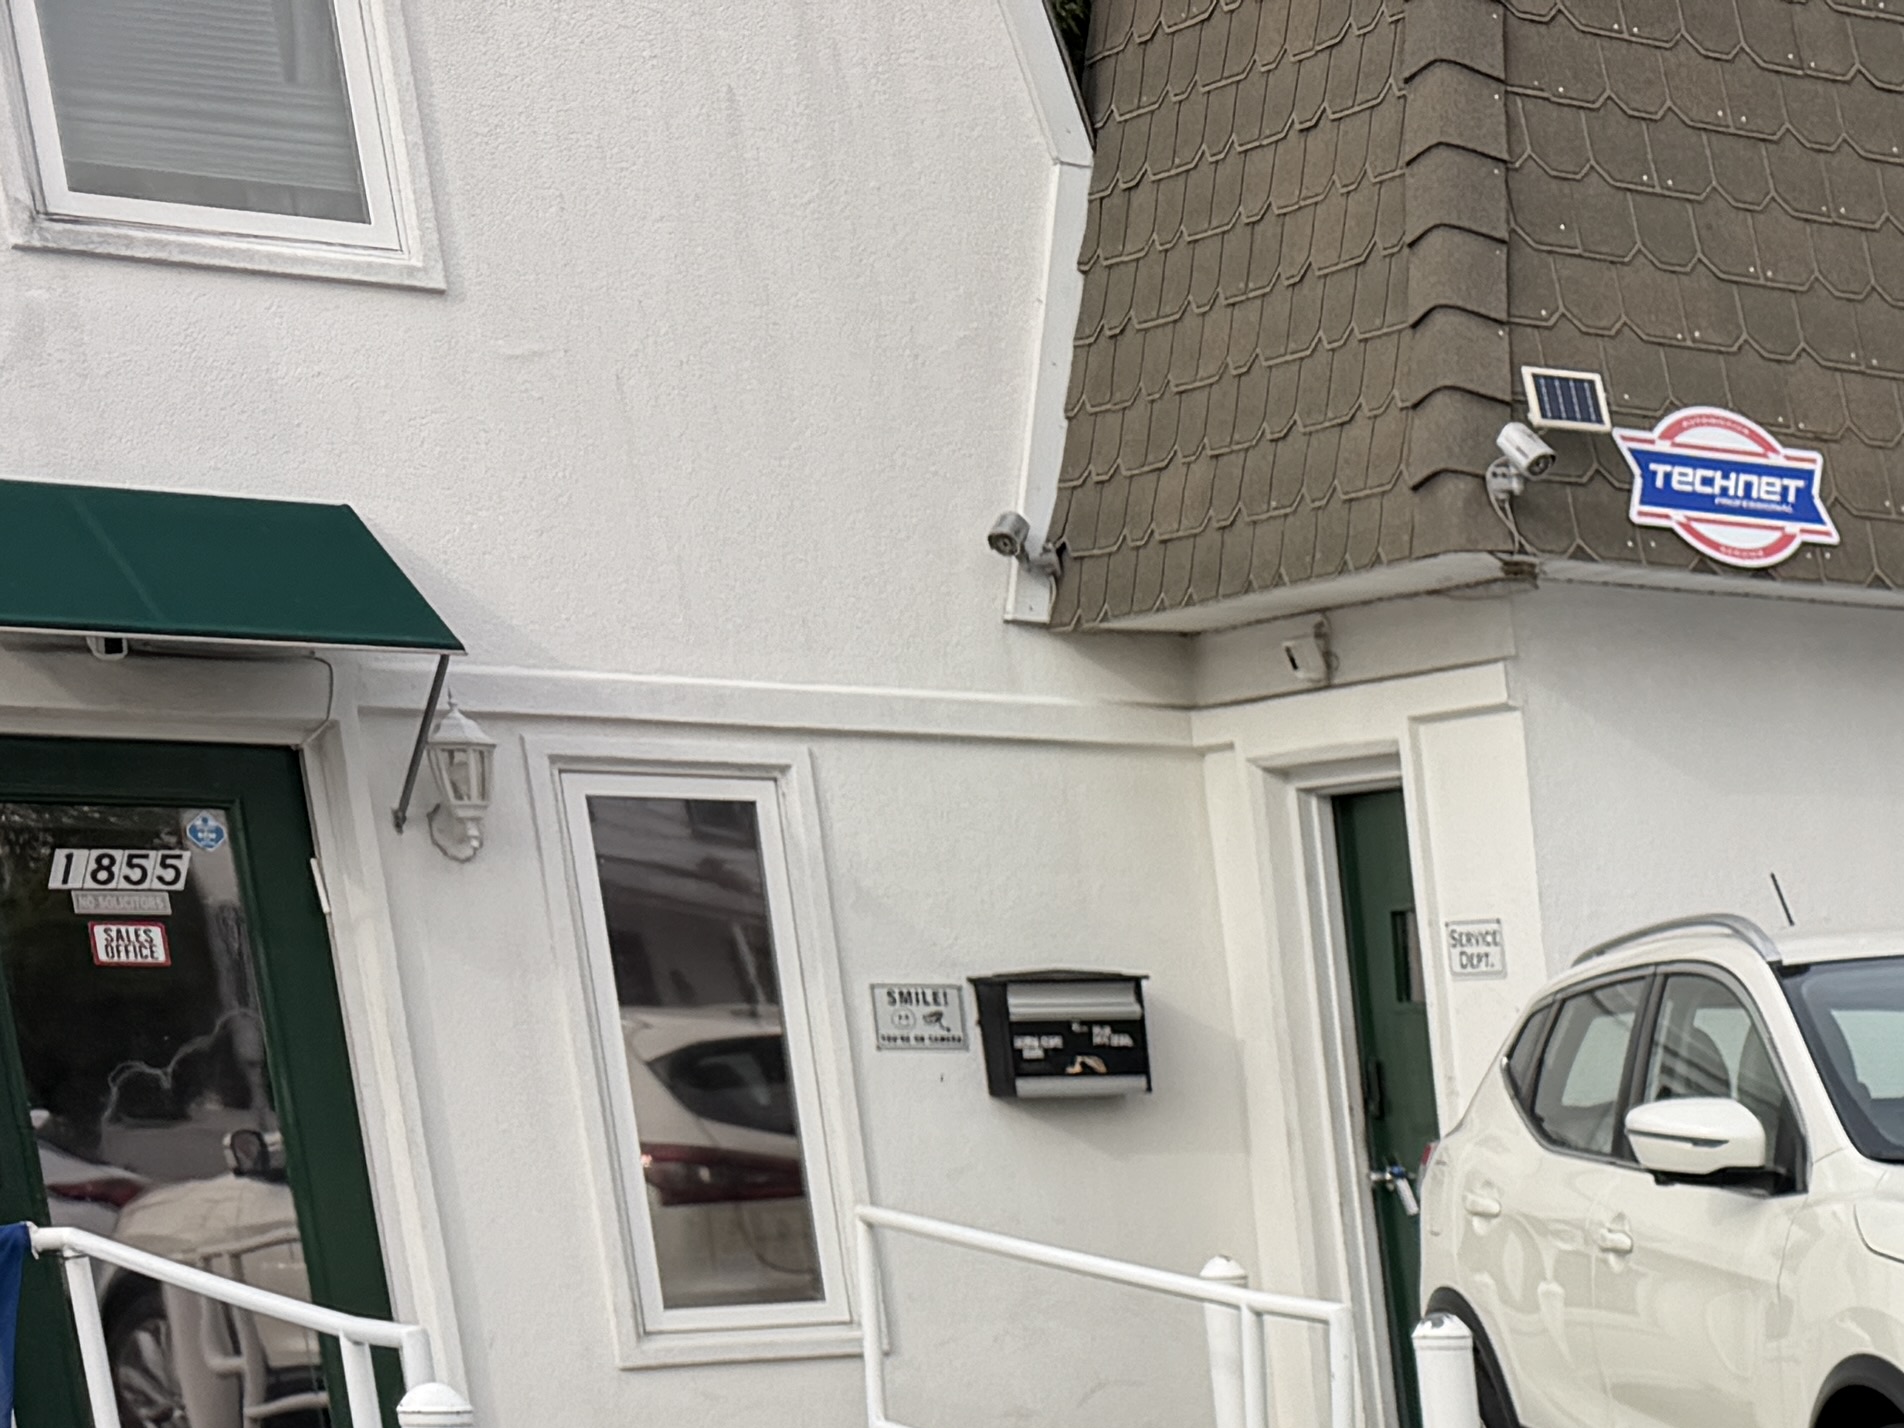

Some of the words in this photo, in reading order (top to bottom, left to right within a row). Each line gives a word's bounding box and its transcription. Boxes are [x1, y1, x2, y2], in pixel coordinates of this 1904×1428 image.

[61, 851, 184, 887] 1855
[103, 927, 154, 945] SALES
[1449, 928, 1501, 949] SERVICE
[104, 943, 160, 961] OFFICE
